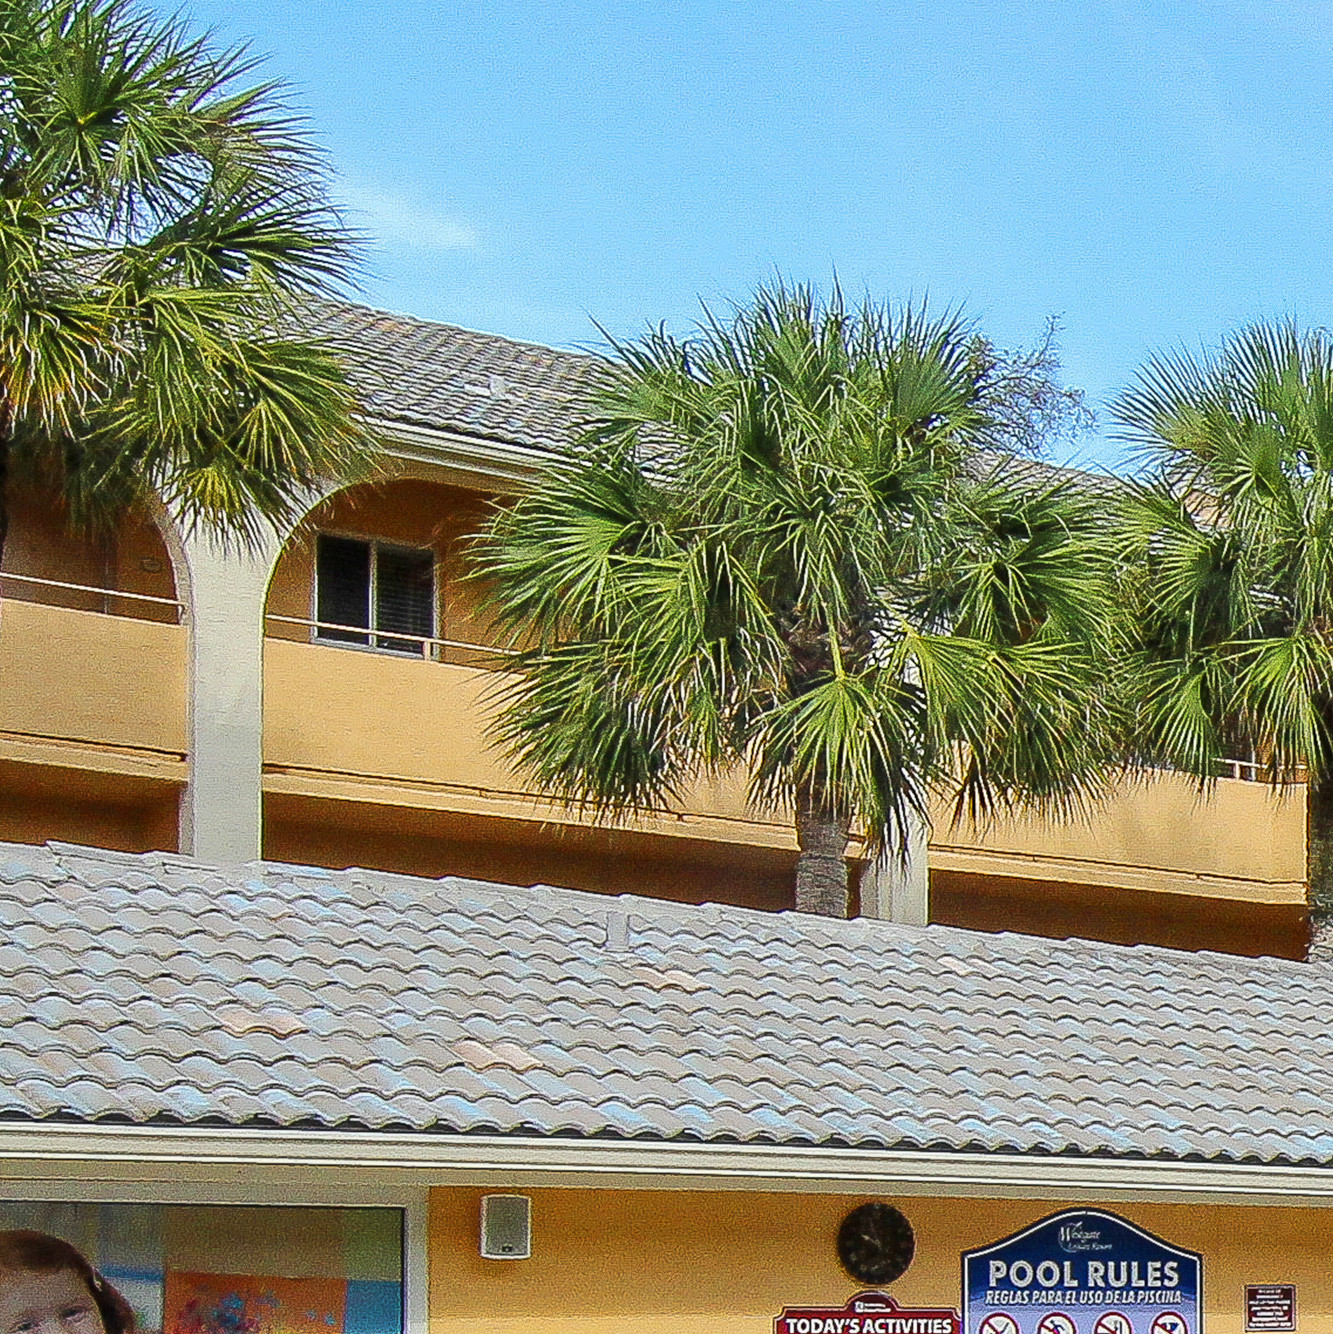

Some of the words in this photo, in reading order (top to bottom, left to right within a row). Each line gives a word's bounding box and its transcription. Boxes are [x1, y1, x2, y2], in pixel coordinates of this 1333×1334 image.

[989, 1260, 1078, 1288] POOL
[1088, 1261, 1179, 1288] RULES
[985, 1290, 1030, 1304] REGLAS
[1032, 1290, 1064, 1304] PARA
[1065, 1290, 1077, 1304] EL
[1080, 1290, 1105, 1304] USO
[1105, 1290, 1121, 1304] DE
[1122, 1290, 1136, 1304] LA
[1137, 1290, 1182, 1304] PISCINA
[786, 1318, 861, 1334] TODAY'S
[863, 1318, 952, 1334] ACTIVITIES
